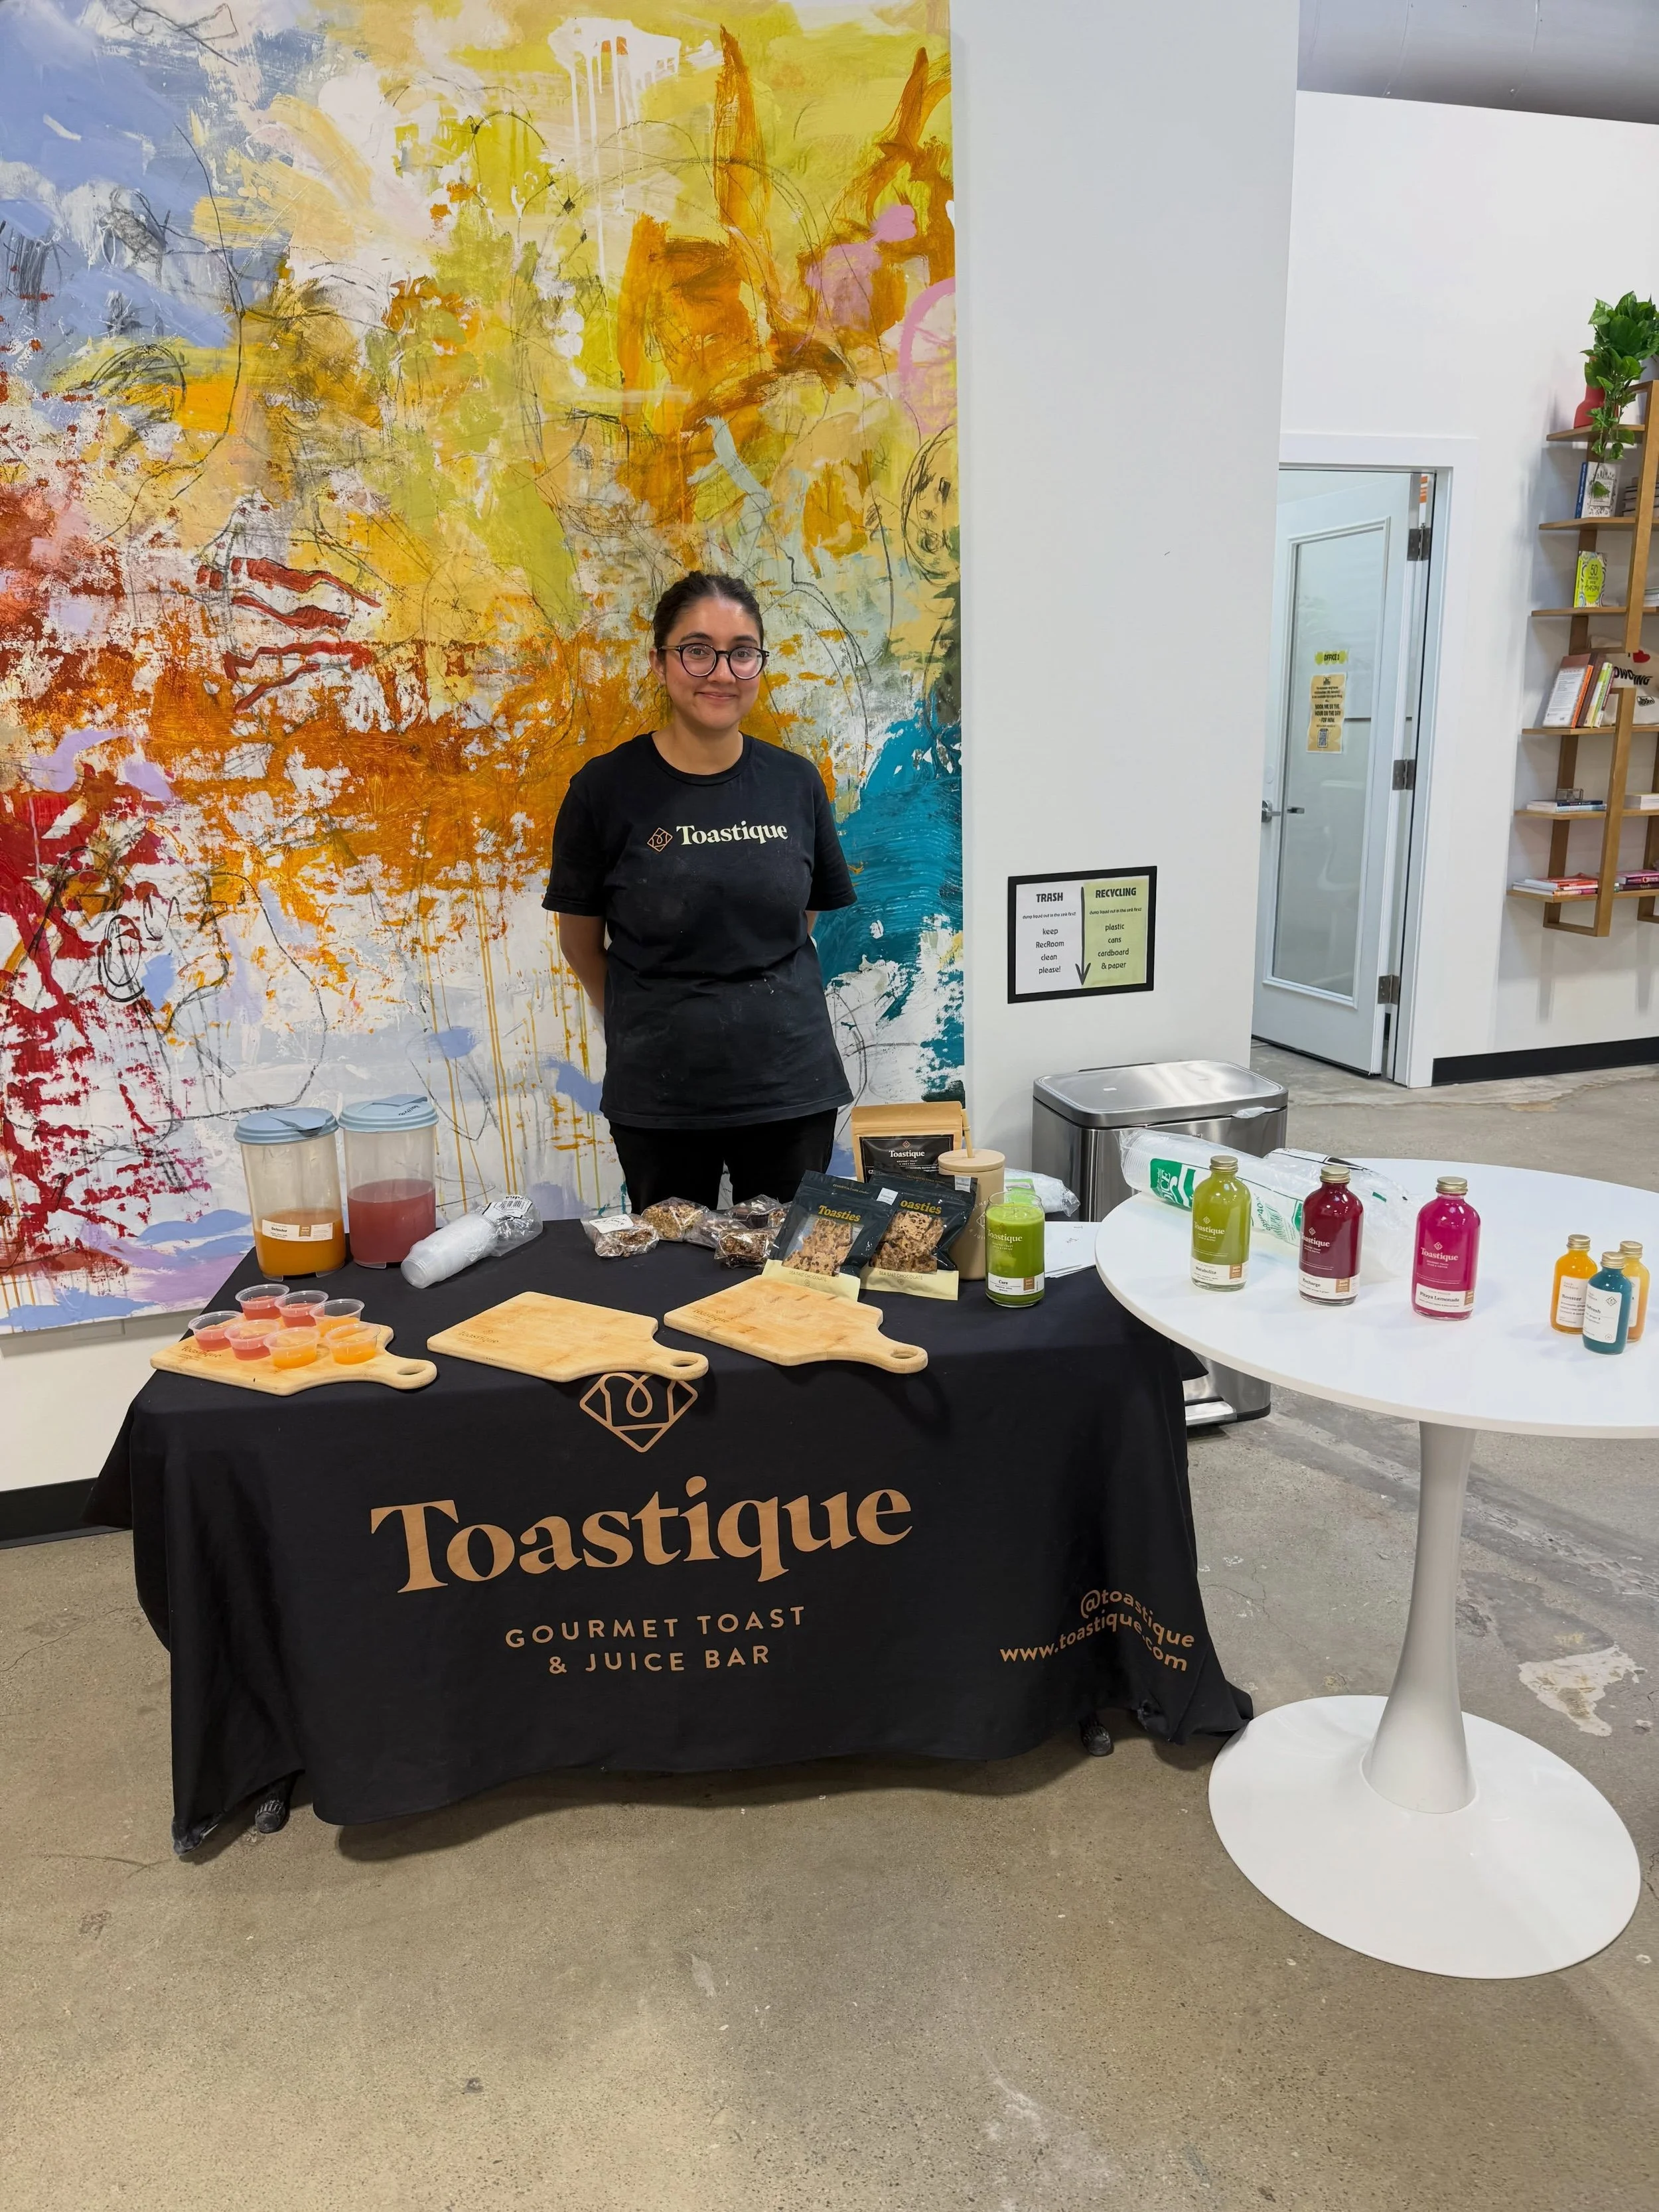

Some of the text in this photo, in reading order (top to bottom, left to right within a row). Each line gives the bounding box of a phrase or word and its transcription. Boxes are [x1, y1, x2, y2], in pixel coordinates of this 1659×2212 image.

[676, 820, 788, 846] Toastique
[1036, 892, 1064, 903] TRASH
[1095, 887, 1137, 899] RECYCLING
[1105, 923, 1125, 932] plastic
[1098, 948, 1129, 957] cardboard
[1039, 966, 1061, 974] please!
[889, 1150, 925, 1159] Toastique
[818, 1205, 861, 1222] Toasties
[900, 1200, 942, 1215] oasties
[986, 1228, 1024, 1244] Toastique
[1194, 1220, 1226, 1236] Toastique
[1301, 1231, 1331, 1248] Toastique
[1420, 1246, 1459, 1262] Toastique
[804, 1274, 828, 1282] CHOCOLATE
[1419, 1291, 1433, 1299] Pitaya
[370, 1475, 914, 1593] Toastique
[1080, 1589, 1195, 1648] @toastique
[504, 1605, 807, 1649] GOURMET TOAST
[999, 1609, 1188, 1672] www.toastique.com
[549, 1645, 770, 1674] & JUICE BAR
